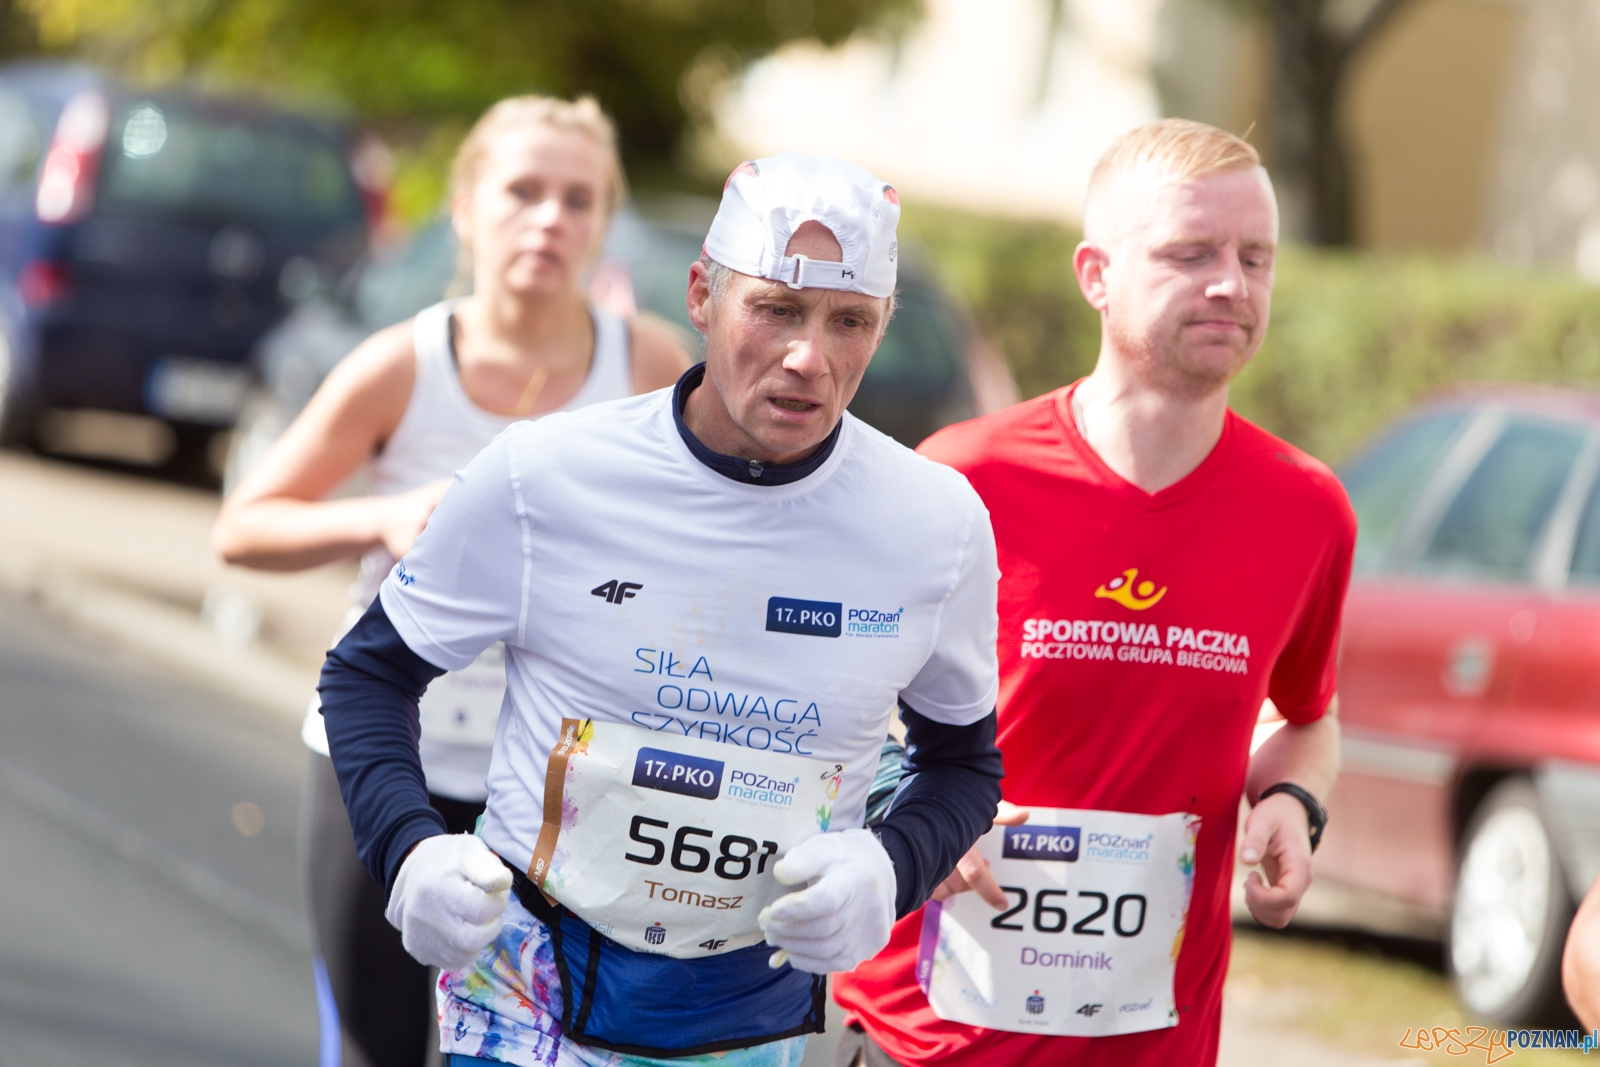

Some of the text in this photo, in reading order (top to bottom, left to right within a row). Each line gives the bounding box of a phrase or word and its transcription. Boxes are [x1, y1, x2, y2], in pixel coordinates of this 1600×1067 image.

[591, 579, 644, 604] 4F
[848, 621, 899, 633] maraton
[1022, 618, 1250, 658] SPORTOWA PACZKA
[634, 647, 713, 682] SIŁA
[1020, 641, 1248, 675] POCZTOWA GRUPA BIEGOWA
[657, 684, 821, 727] ODWAGA
[728, 785, 793, 806] maraton
[624, 815, 779, 880] 5681
[1086, 846, 1150, 861] maraton
[644, 879, 744, 910] Tomasz
[990, 886, 1147, 938] 2620
[699, 938, 729, 950] 4F
[1020, 947, 1114, 971] Dominik
[1075, 1003, 1104, 1018] 4F
